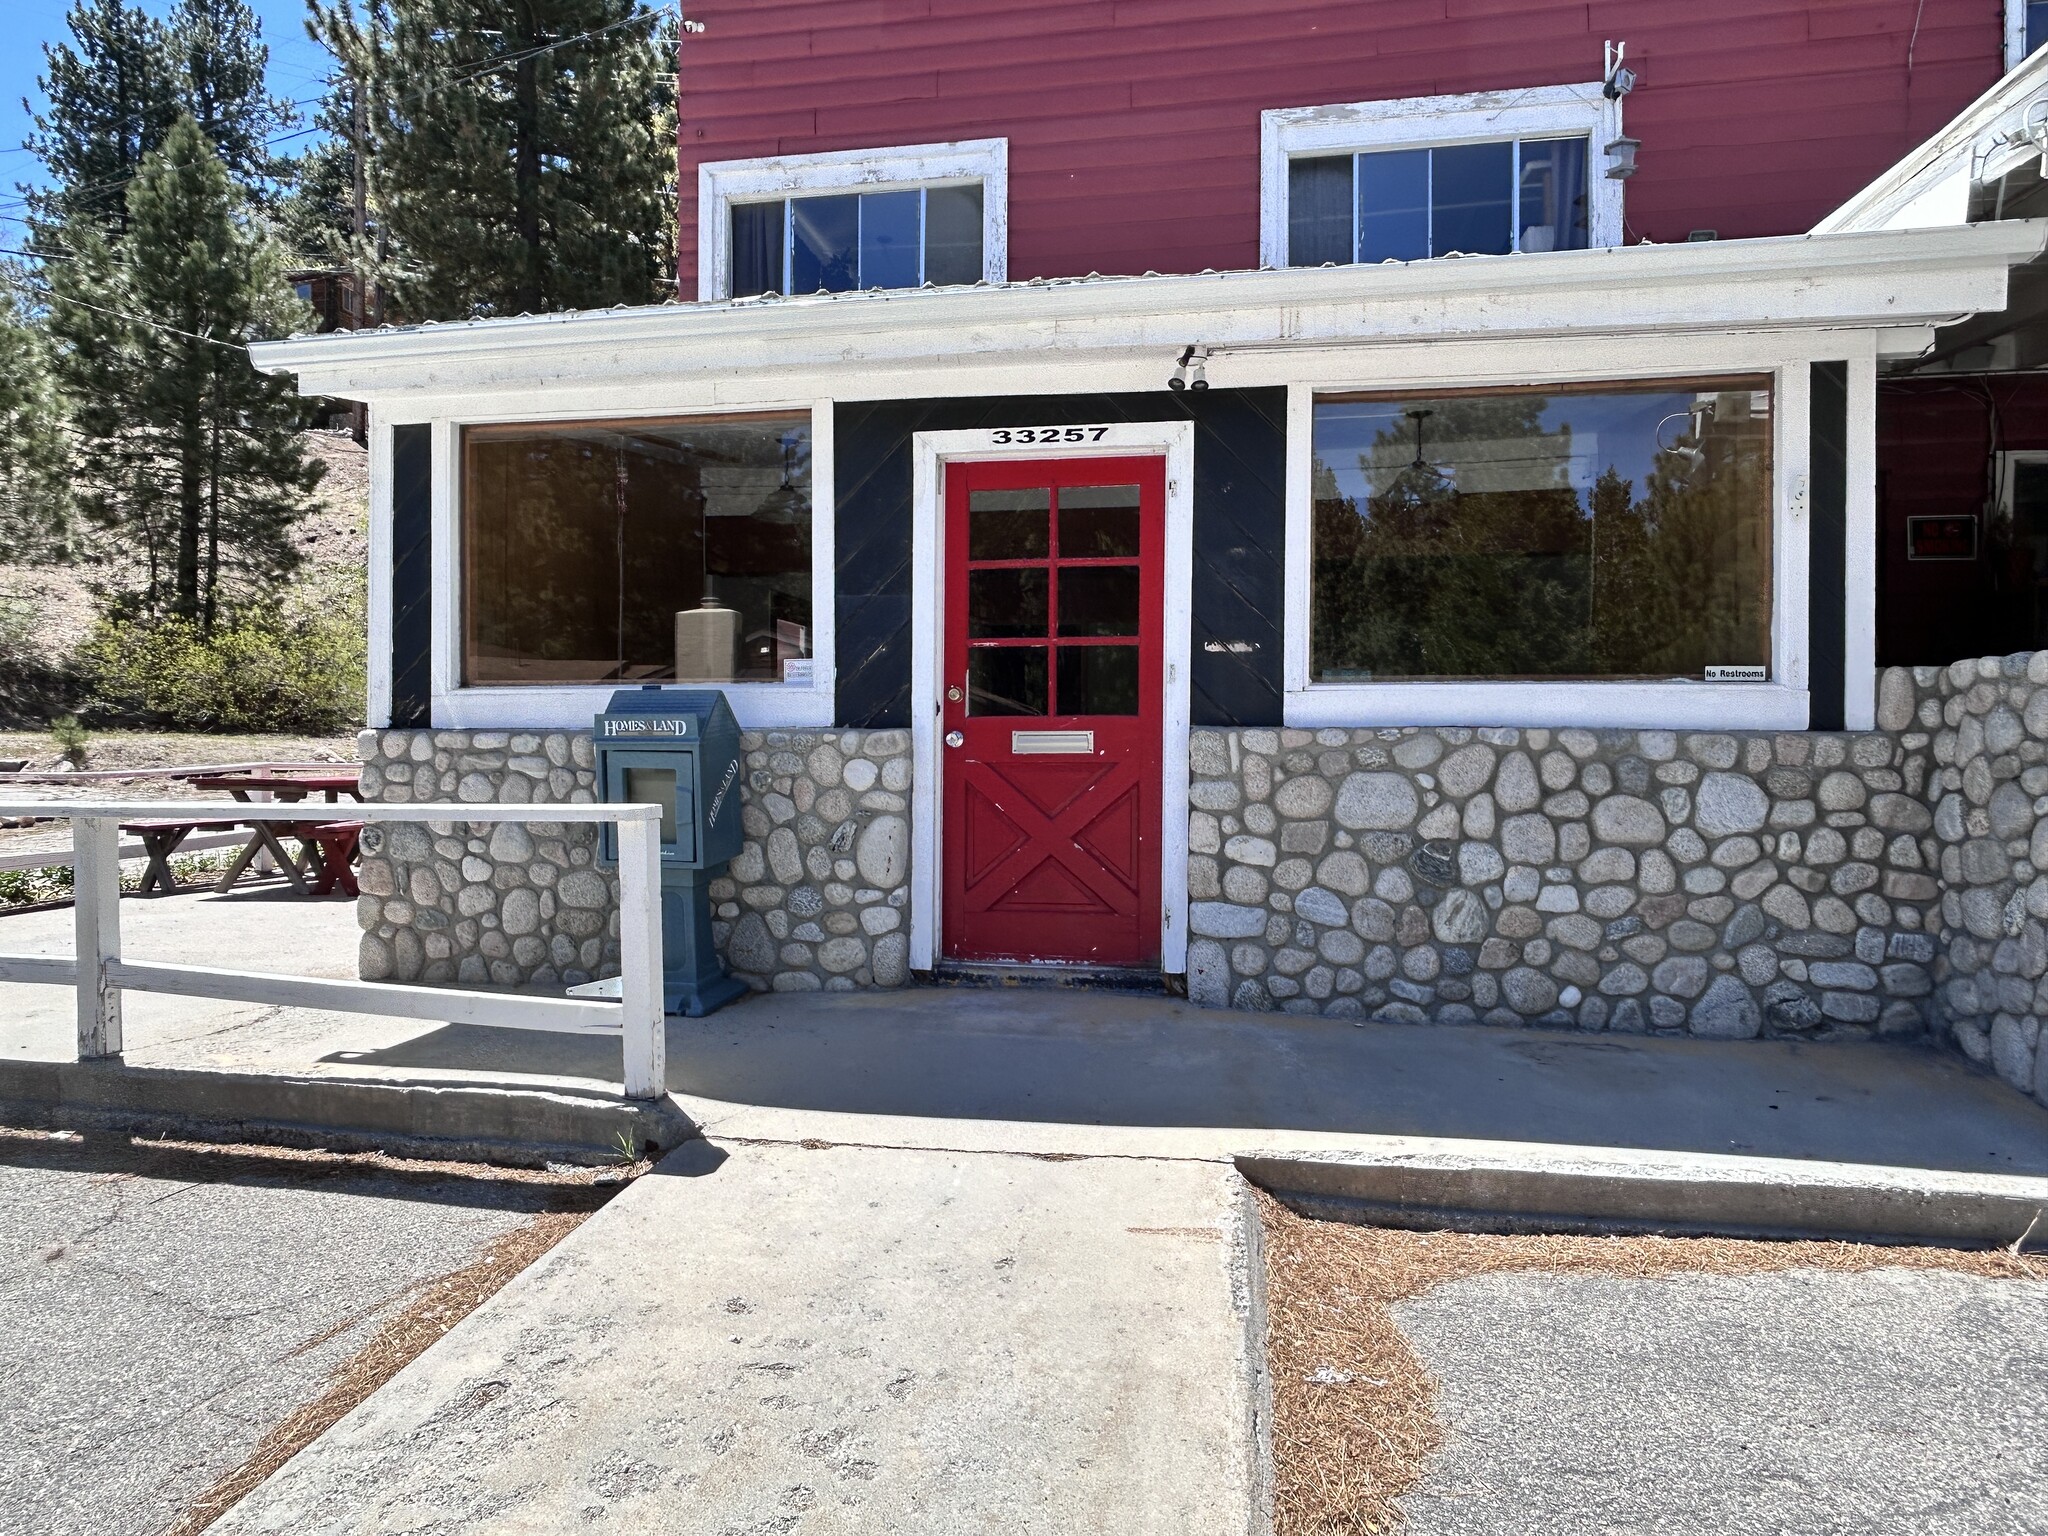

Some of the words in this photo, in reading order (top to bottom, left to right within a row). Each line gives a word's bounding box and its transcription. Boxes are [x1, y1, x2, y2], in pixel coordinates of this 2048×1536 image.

[992, 427, 1109, 444] 33257
[1706, 669, 1716, 678] No
[1720, 669, 1764, 678] Restrooms
